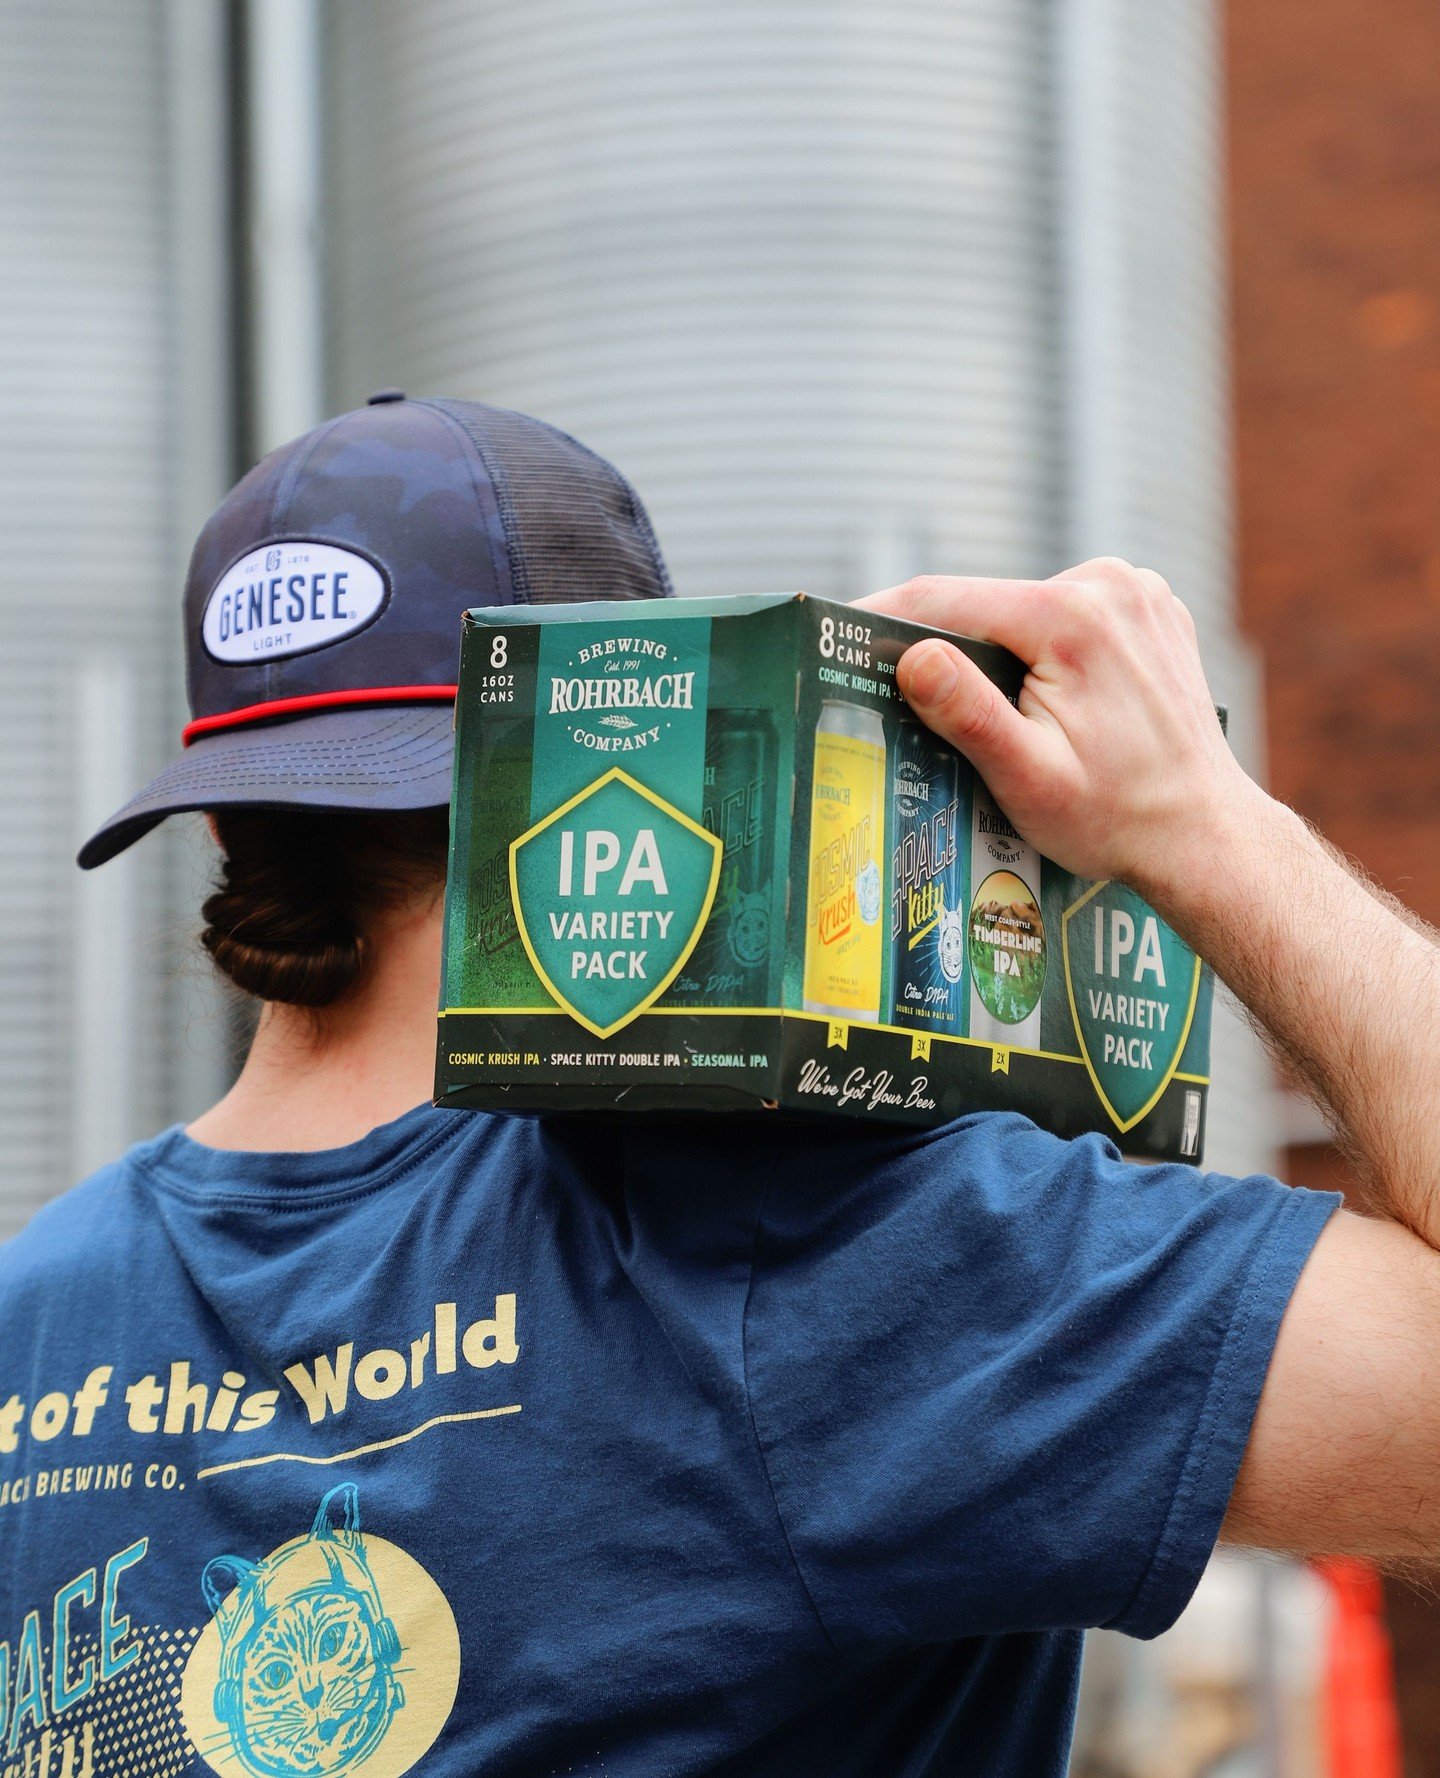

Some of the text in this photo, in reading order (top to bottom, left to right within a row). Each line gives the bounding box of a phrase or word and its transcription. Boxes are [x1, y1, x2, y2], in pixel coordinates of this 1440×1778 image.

[219, 572, 348, 642] GENESEE
[253, 633, 292, 651] LIGHT
[819, 617, 835, 658] 8
[838, 621, 871, 645] 16OZ
[490, 635, 507, 668] 8
[578, 638, 667, 664] BREWING
[837, 645, 871, 668] CANS
[623, 660, 640, 671] 1991
[482, 675, 514, 687] 16OZ
[549, 672, 695, 714] ROHRBACH
[819, 667, 849, 687] COSMIC
[852, 676, 877, 694] KRUSH
[879, 683, 891, 698] IPA
[480, 690, 514, 703] CANS
[573, 726, 660, 751] COMPANY
[558, 829, 669, 897] IPA
[988, 844, 1020, 863] COMPANY
[549, 911, 674, 940] VARIETY
[974, 924, 1042, 954] TIMBERLINE
[1094, 906, 1167, 988] IPA
[571, 951, 647, 979] PACK
[994, 949, 1021, 977] IPA
[896, 1004, 913, 1015] DOUBLE
[916, 1008, 930, 1018] INDIA
[932, 1011, 945, 1021] PALE
[1088, 989, 1170, 1032] VARIETY
[833, 1026, 843, 1039] 3X
[916, 1039, 926, 1052] 3X
[449, 1053, 768, 1068] COSMIC KRUSH IPA SPACE KITTY DOUBLE IPA SEASONAL IPA
[996, 1052, 1005, 1064] 2X
[1104, 1034, 1153, 1071] PACK
[798, 1059, 936, 1111] We've Got Your Beer
[30, 1366, 113, 1442] of
[125, 1361, 281, 1434] this
[283, 1293, 520, 1424] World
[36, 1463, 133, 1498] BREWING
[145, 1463, 186, 1491] CO.
[0, 1537, 149, 1757] ACE
